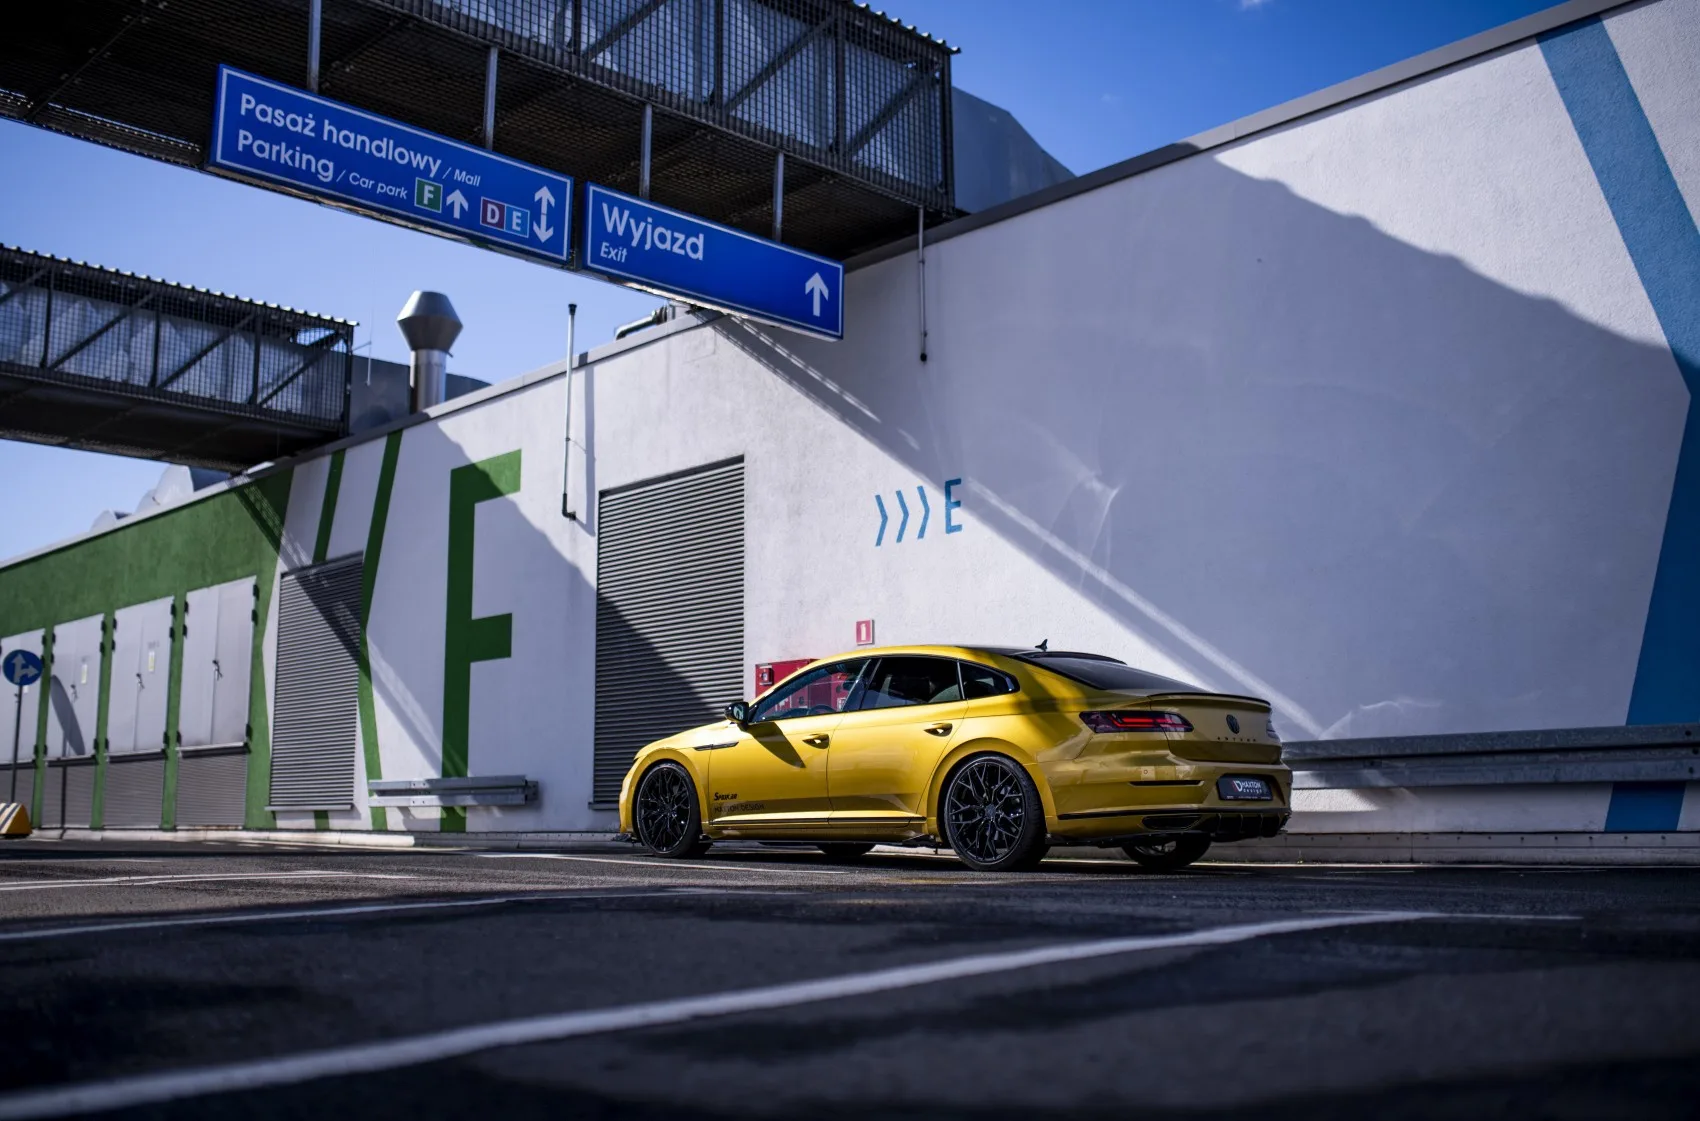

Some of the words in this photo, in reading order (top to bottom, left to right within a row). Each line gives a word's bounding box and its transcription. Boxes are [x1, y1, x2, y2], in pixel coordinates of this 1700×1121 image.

[237, 129, 335, 183] Parking
[349, 173, 375, 190] Car
[376, 180, 408, 200] park
[423, 185, 435, 205] F
[240, 93, 316, 138] Pasaż
[322, 118, 442, 178] handlowy
[453, 168, 482, 188] Mall
[485, 203, 500, 225] D
[511, 211, 522, 232] E
[602, 202, 705, 261] Wyjazd
[599, 241, 628, 263] Exit
[944, 478, 962, 534] E
